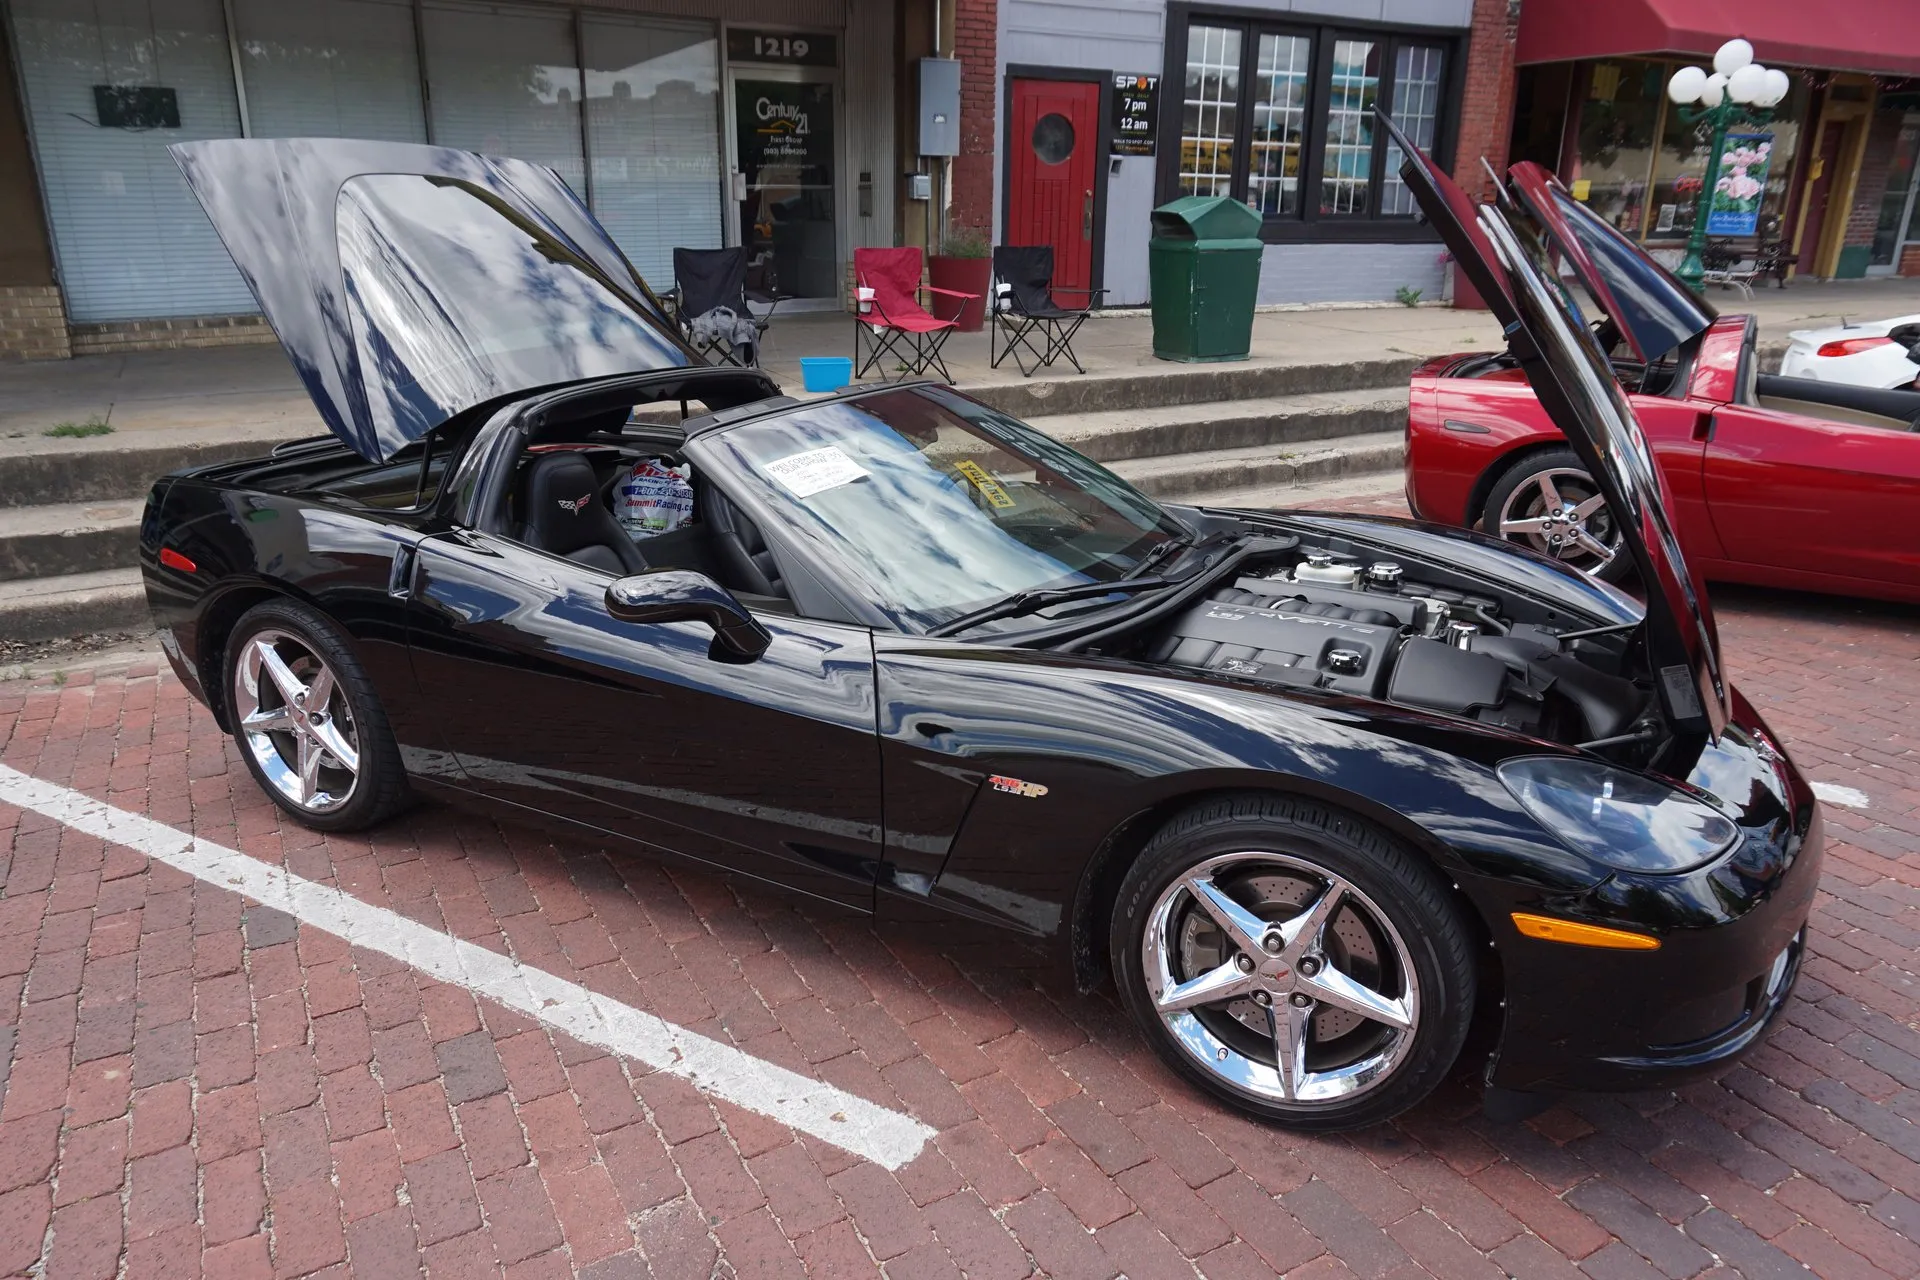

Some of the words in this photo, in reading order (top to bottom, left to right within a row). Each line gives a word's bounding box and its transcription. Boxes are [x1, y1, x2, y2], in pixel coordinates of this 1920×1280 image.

[754, 36, 809, 57] 1219
[755, 96, 799, 120] Century
[1124, 98, 1131, 110] 7
[1132, 101, 1147, 112] pm
[795, 113, 809, 134] 21
[1121, 117, 1132, 129] 12
[1134, 120, 1148, 130] am
